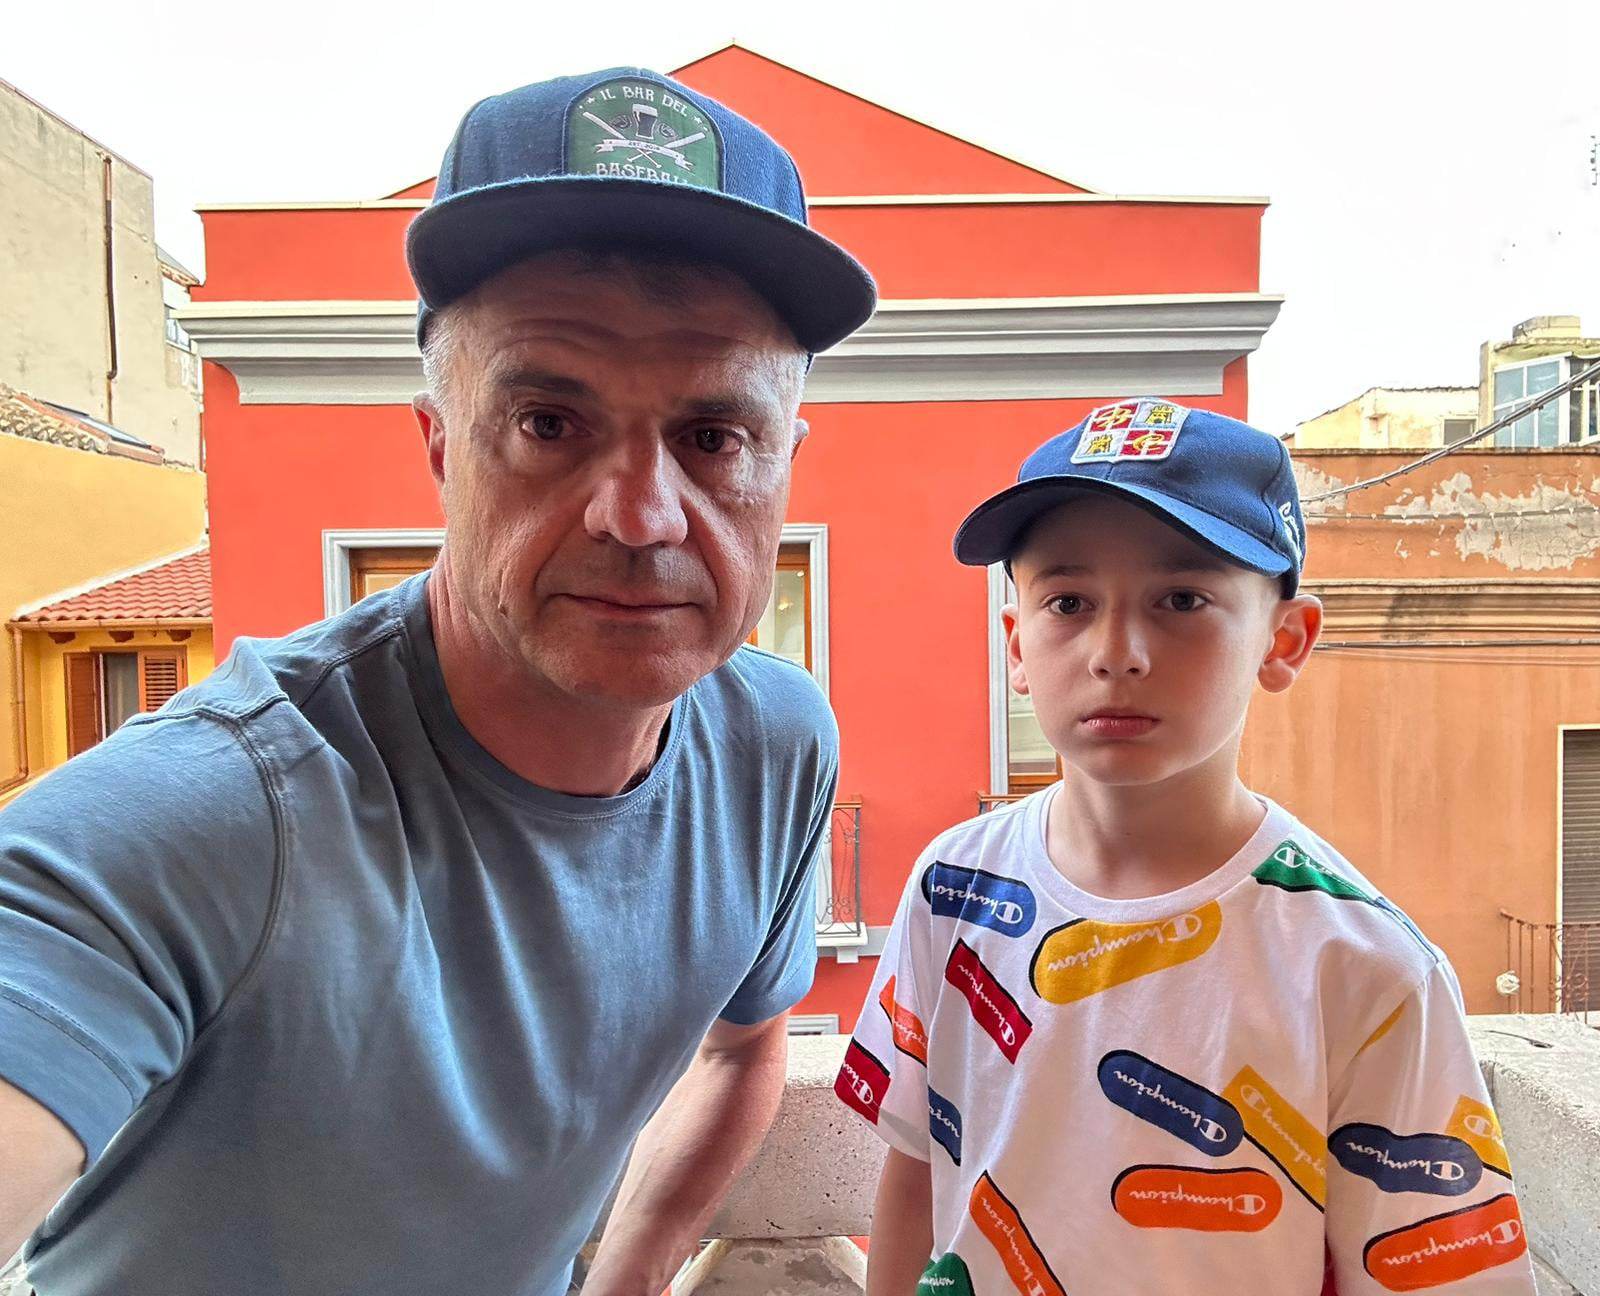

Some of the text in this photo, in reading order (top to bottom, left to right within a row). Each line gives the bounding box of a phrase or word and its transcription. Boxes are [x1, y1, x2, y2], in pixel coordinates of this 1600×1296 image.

[600, 86, 688, 117] IL BAR DEL
[932, 883, 1024, 925] Champio
[1047, 914, 1203, 974] Champion
[957, 965, 1016, 1046] Champion
[1114, 1069, 1228, 1144] Champion
[1345, 1140, 1466, 1182] Champion
[1129, 1183, 1266, 1216] Champion
[1382, 1219, 1523, 1267] Champion
